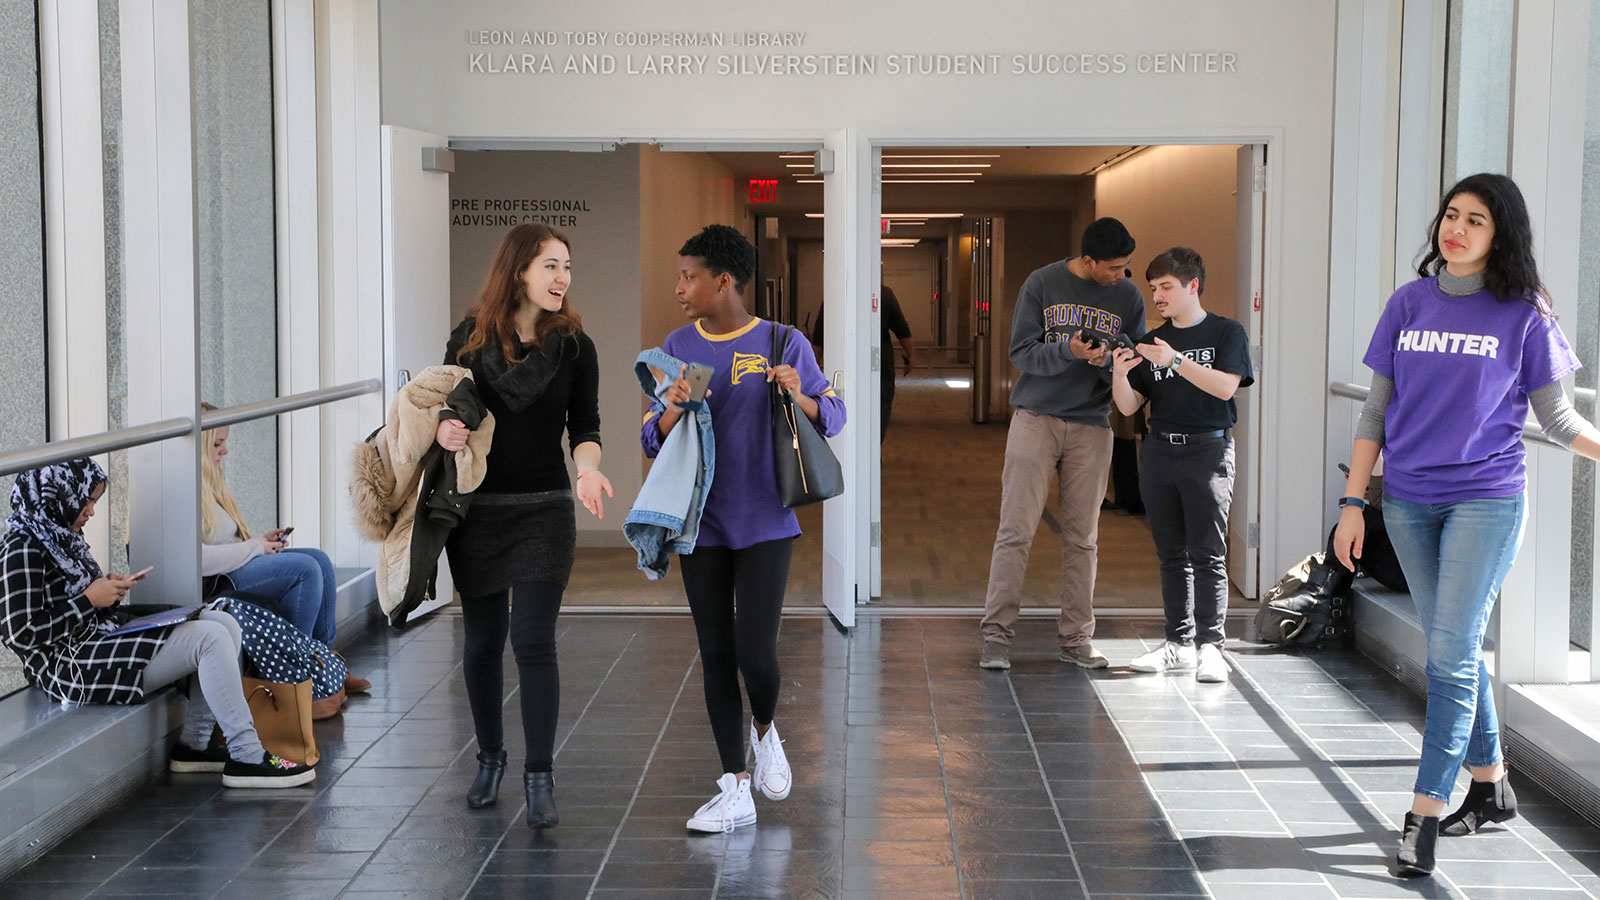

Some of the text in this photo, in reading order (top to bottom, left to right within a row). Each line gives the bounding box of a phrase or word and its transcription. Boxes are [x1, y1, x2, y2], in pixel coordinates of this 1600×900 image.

[469, 30, 807, 47] LEON AND TOBY COOPERMAN LIBRARY
[468, 52, 1238, 76] KLARA AND LARRY SILVERSTEIN STUDENT SUCCESS CENTER
[749, 179, 779, 203] EXIT
[451, 199, 591, 212] PRE PROFESSIONAL
[452, 214, 518, 227] ADVISING
[1044, 304, 1122, 336] HUNTER
[1397, 330, 1500, 359] HUNTER
